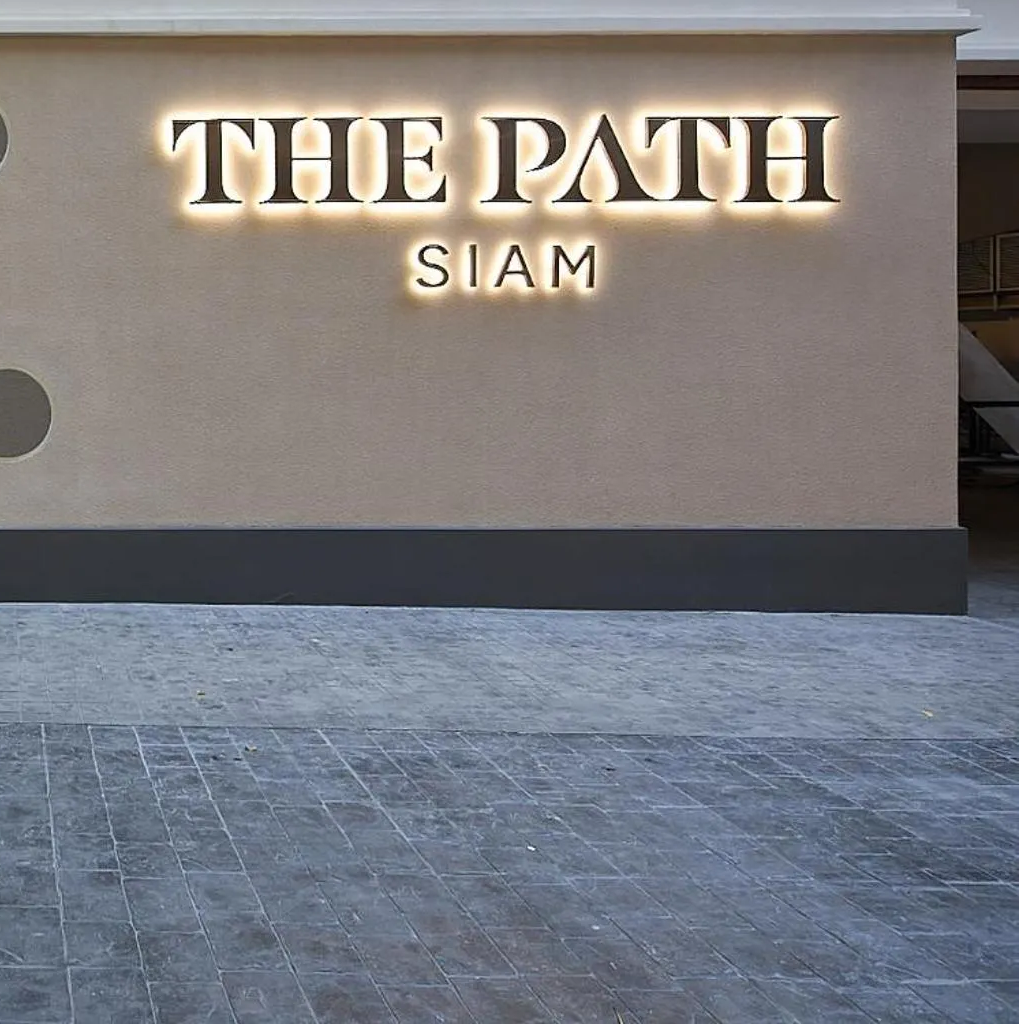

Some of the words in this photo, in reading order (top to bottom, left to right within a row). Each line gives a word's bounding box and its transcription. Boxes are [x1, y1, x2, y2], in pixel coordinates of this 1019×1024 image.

[171, 115, 447, 204] THE
[479, 114, 841, 204] PATH
[415, 243, 598, 289] SIAM
